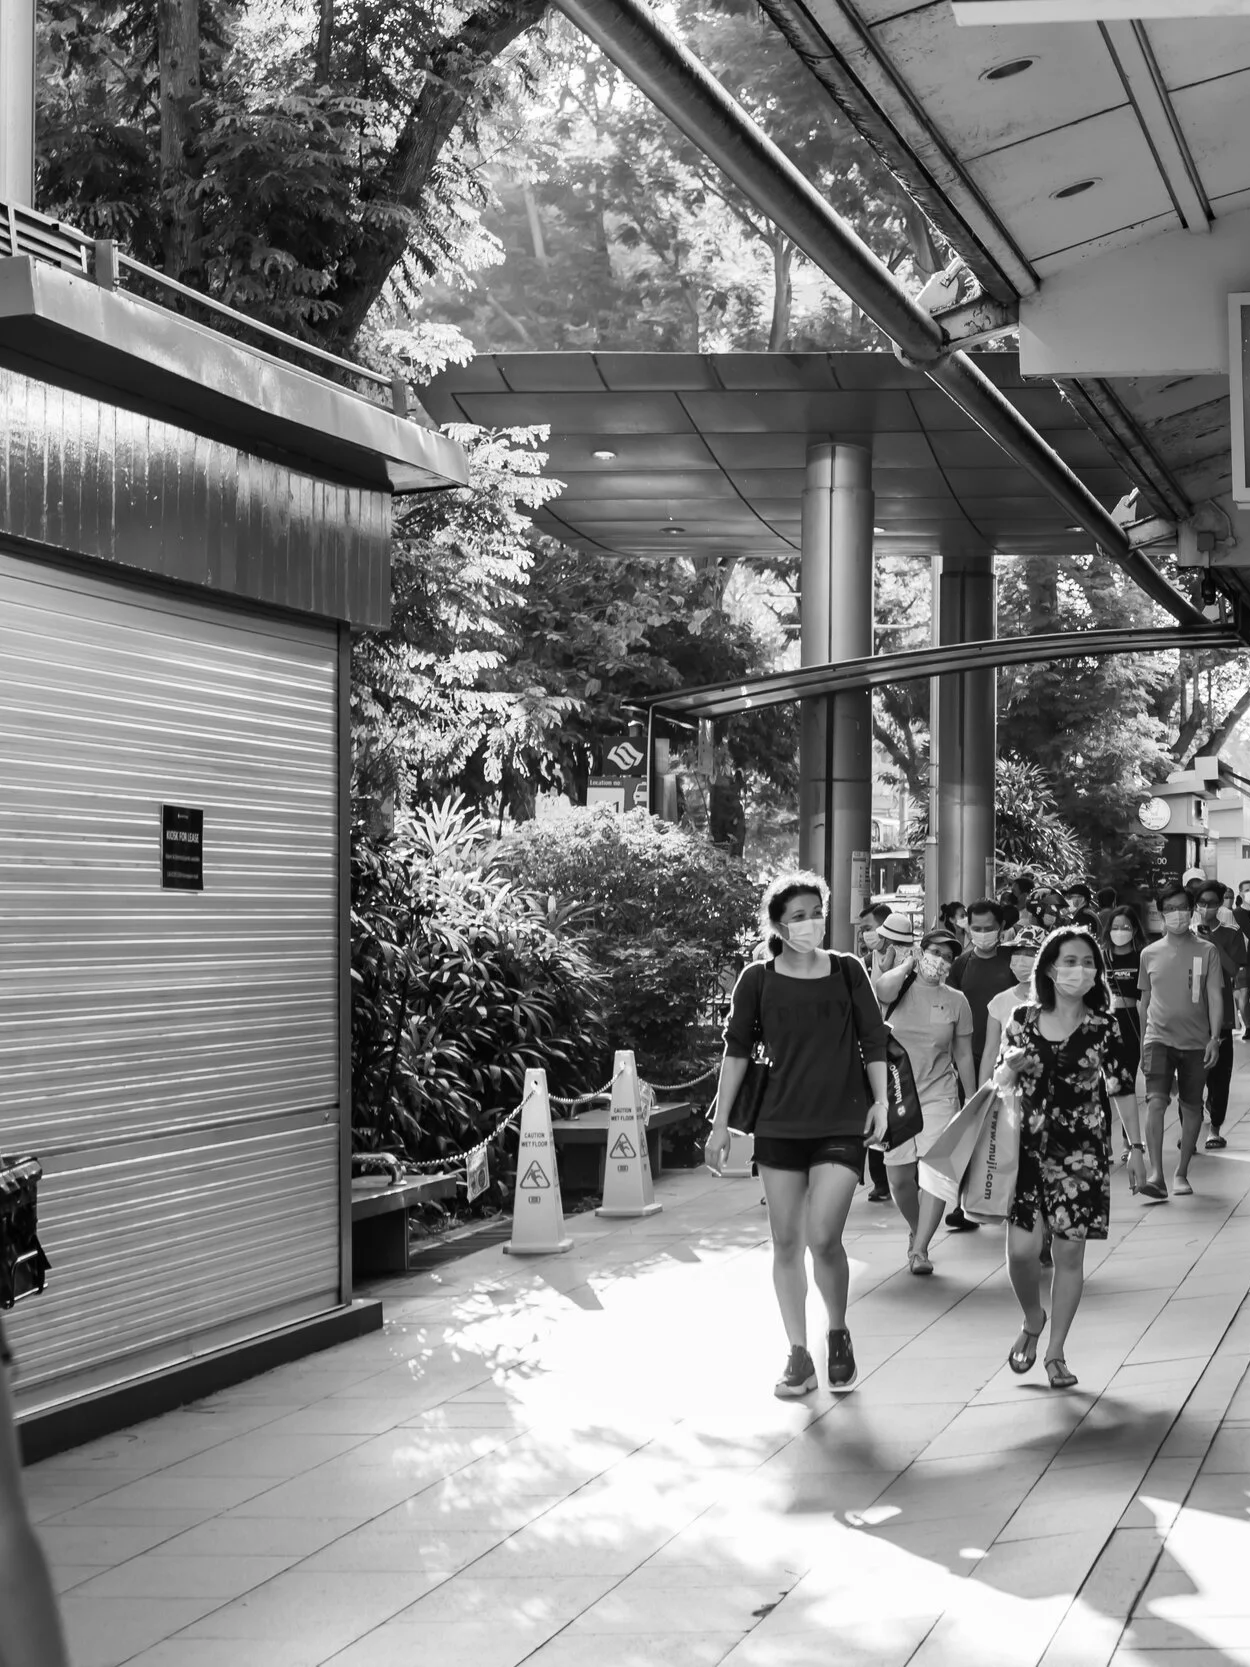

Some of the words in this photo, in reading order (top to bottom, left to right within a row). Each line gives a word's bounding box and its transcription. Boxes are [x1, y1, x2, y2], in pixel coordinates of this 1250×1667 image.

[166, 830, 178, 841] KIOSK
[179, 832, 187, 842] FOR
[187, 833, 200, 843] LEASE
[984, 1110, 999, 1200] www.muji.com
